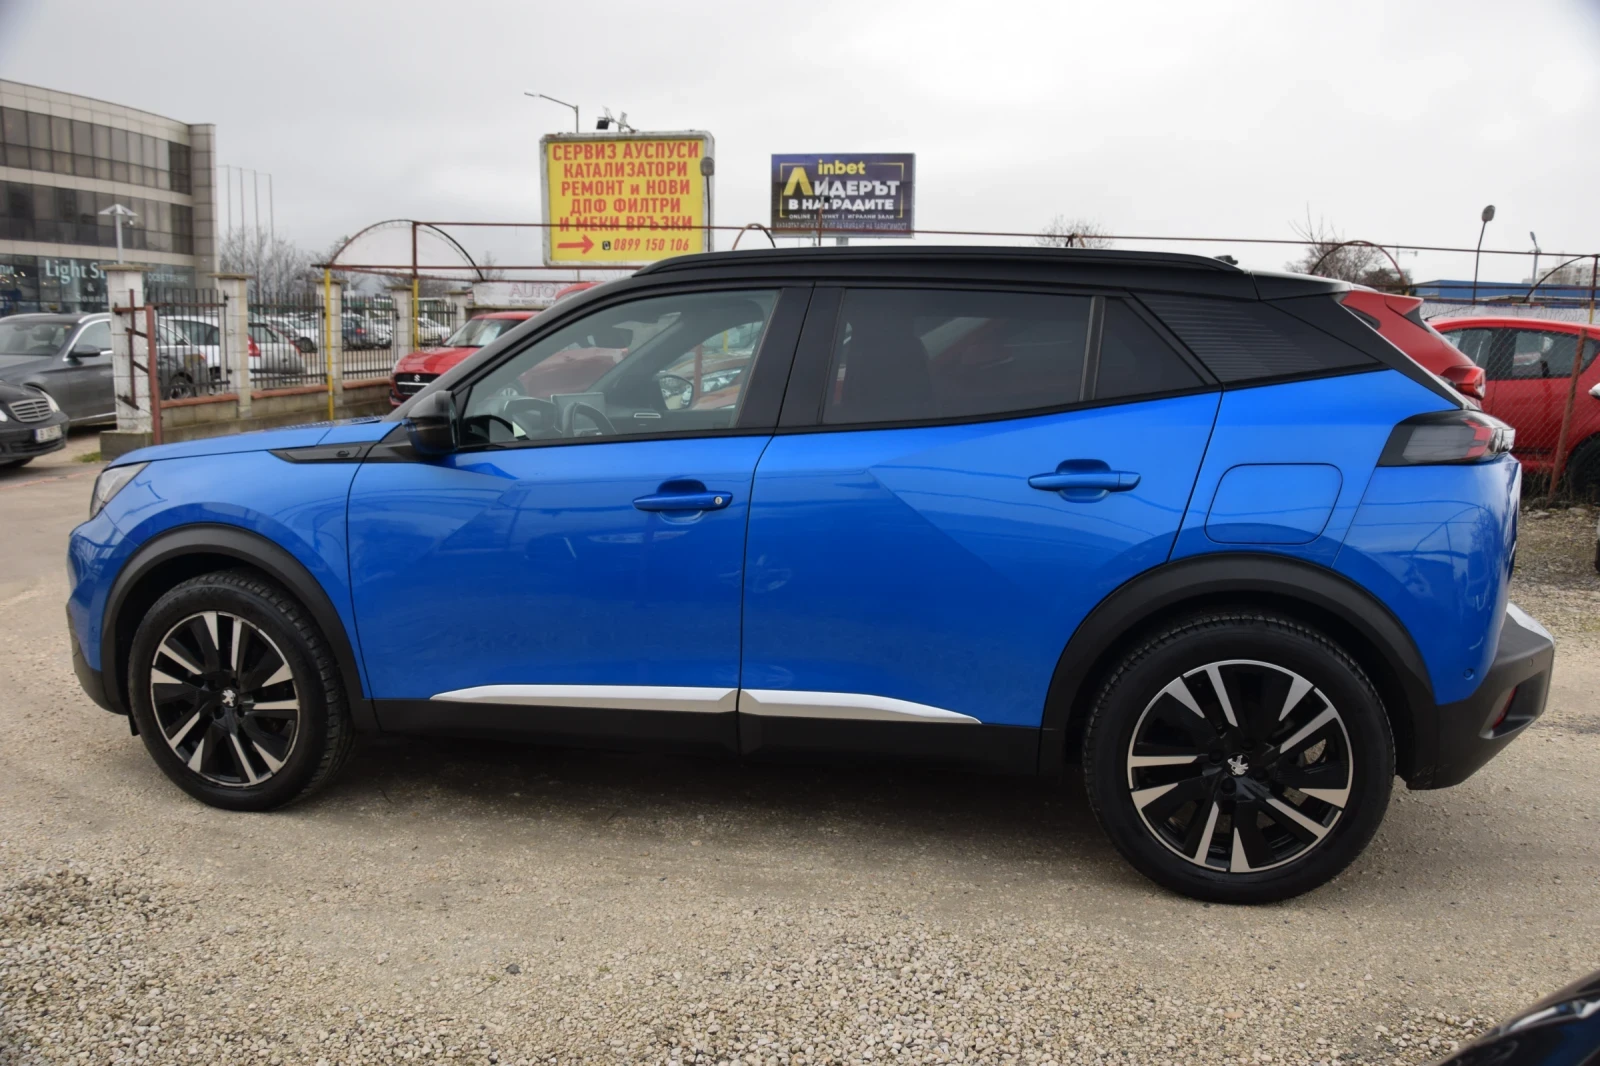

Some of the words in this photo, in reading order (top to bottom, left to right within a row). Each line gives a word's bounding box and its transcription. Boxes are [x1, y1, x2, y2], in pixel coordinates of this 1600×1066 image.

[552, 143, 617, 161] СЕРВИЗ
[623, 142, 699, 159] АУСПУСИ
[563, 161, 687, 178] КАТАЛИЗАТОРИ
[817, 158, 866, 175] inbet
[561, 180, 625, 196] РЕМОНТ
[646, 179, 690, 195] НОВИ
[570, 198, 607, 216] ДПФ
[613, 197, 681, 213] ФИЛТРИ
[788, 199, 799, 210] В
[559, 217, 570, 232] И
[576, 216, 620, 232] МЕКИ
[626, 215, 693, 231] ВРЪЗКИ
[613, 239, 641, 252] 0899
[645, 239, 666, 252] 150
[670, 238, 690, 251] 106
[45, 259, 87, 285] Light
[75, 293, 106, 303] Sound
